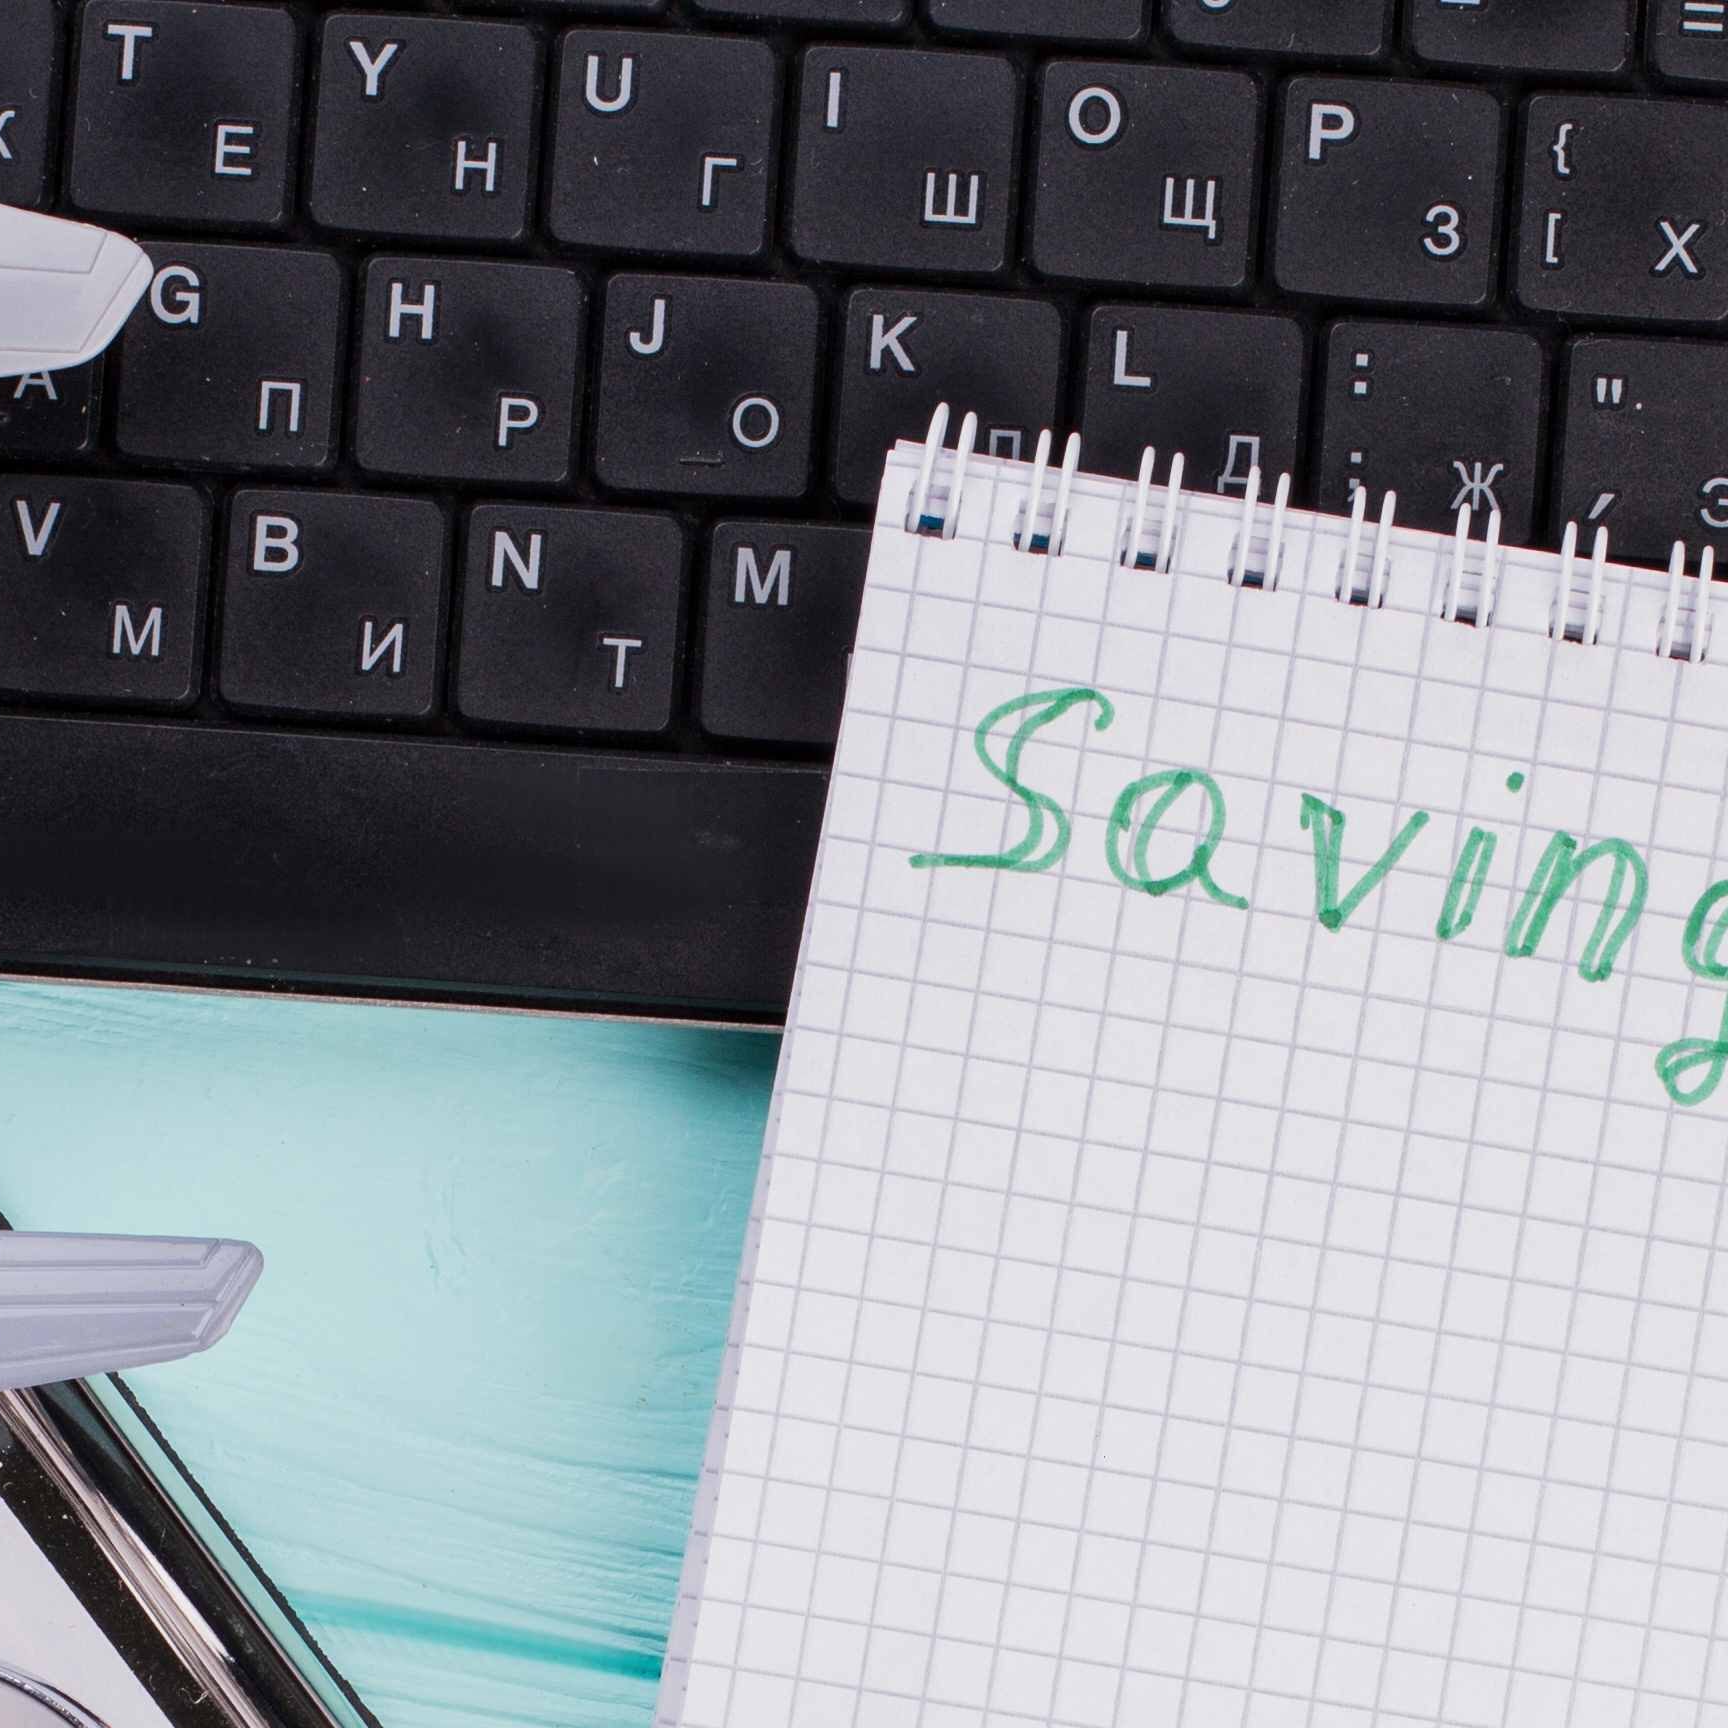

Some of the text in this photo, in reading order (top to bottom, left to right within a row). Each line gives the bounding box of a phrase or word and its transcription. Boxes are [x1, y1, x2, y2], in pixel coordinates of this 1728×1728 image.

[107, 23, 153, 80] T
[349, 41, 398, 96] Y
[585, 55, 633, 112] U
[1068, 87, 1121, 144] O
[1308, 103, 1355, 160] P
[701, 156, 738, 206] Г
[924, 172, 979, 224] Ш
[1163, 176, 1217, 240] Щ
[150, 265, 200, 324] G
[389, 282, 435, 339] H
[629, 299, 666, 354] J
[870, 314, 917, 371] K
[1113, 330, 1151, 387] L
[258, 380, 301, 432] П
[16, 500, 61, 556] V
[253, 515, 299, 572] B
[491, 530, 542, 590] N
[734, 546, 791, 606] M
[361, 620, 404, 673] И
